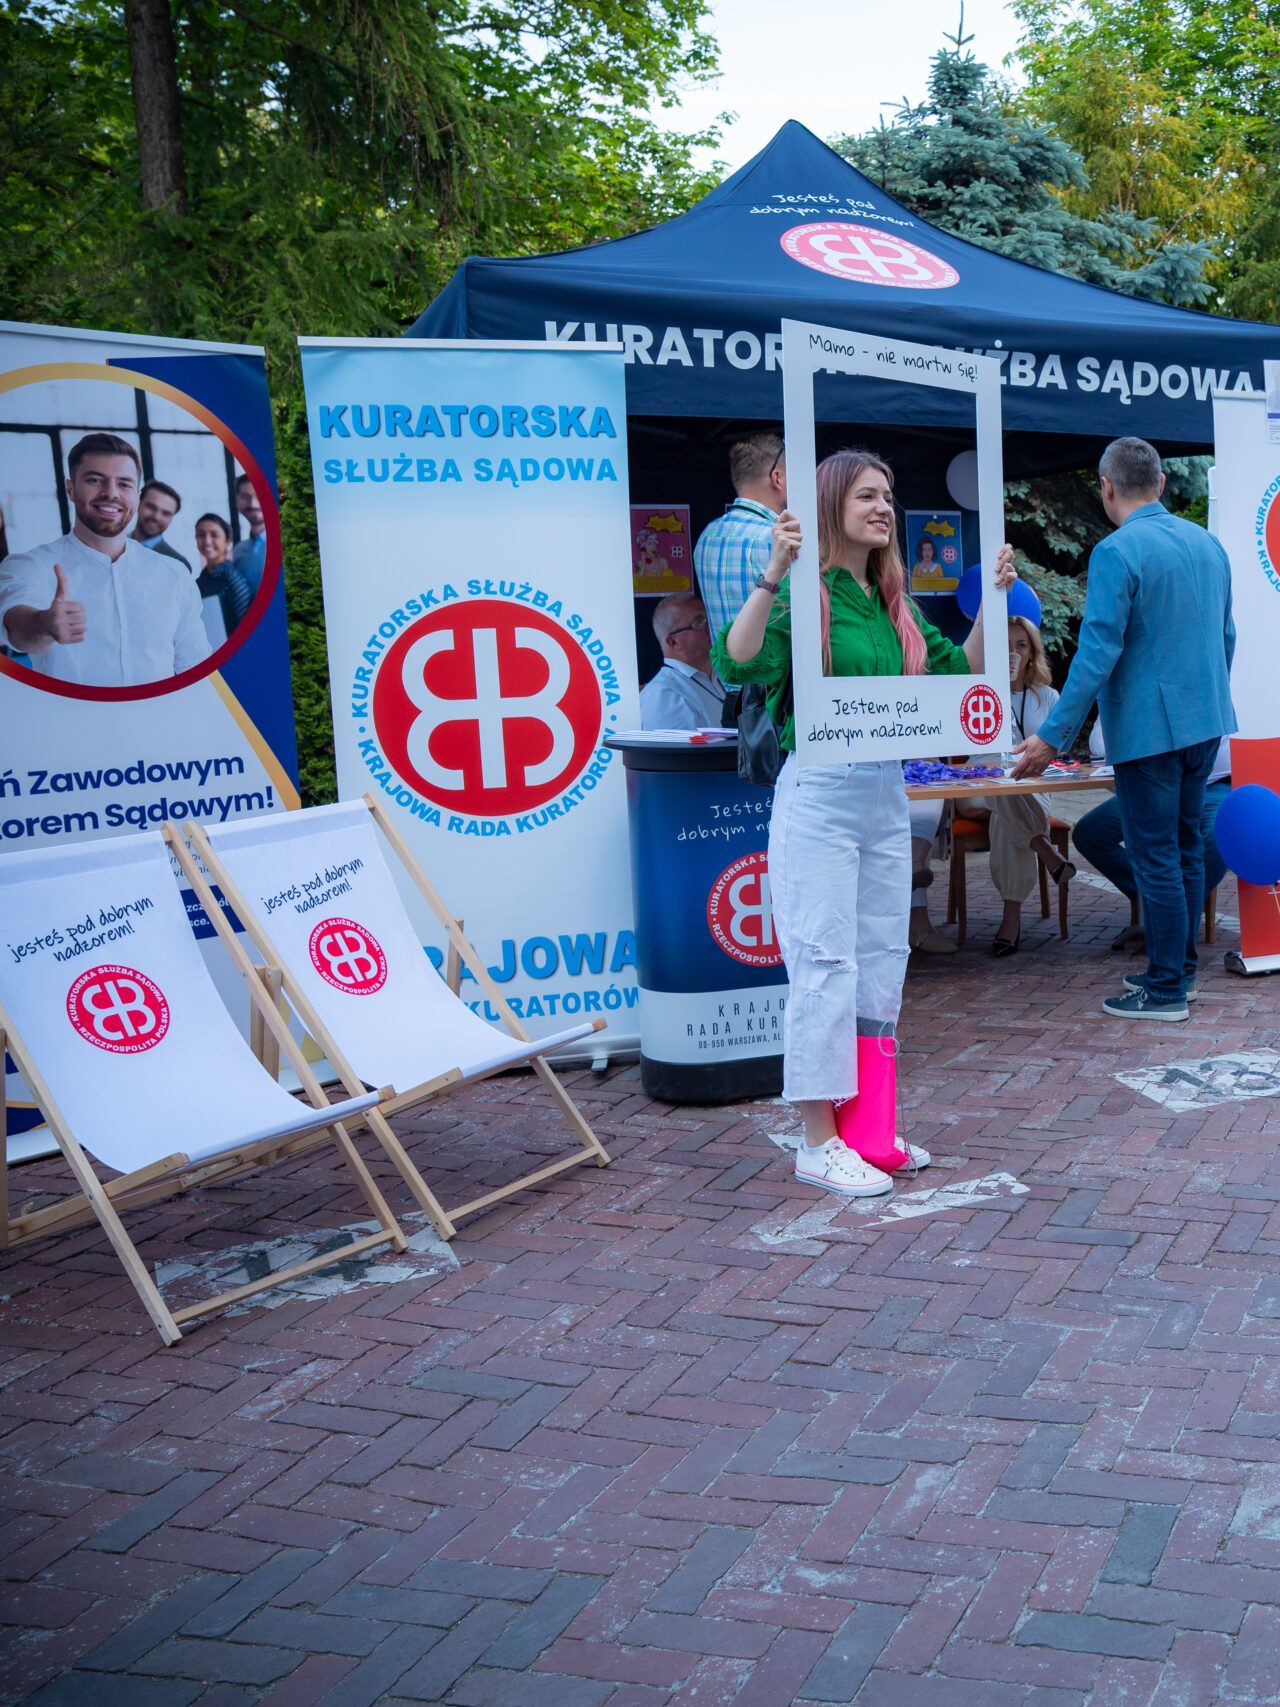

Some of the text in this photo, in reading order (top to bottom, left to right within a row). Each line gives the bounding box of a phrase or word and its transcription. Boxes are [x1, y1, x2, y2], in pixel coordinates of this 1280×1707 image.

[750, 205, 820, 216] dobrym
[772, 193, 876, 210] Jesteś pod
[809, 334, 855, 357] Mamo
[876, 346, 897, 364] nie
[903, 355, 952, 375] martw
[958, 362, 978, 383] się!
[1076, 357, 1255, 405] SĄDOWA
[319, 404, 617, 440] KURATORSKA
[323, 451, 618, 488] SŁUŻBA SĄDOWA
[351, 579, 621, 718] KURATORSKA SŁUŻBA SĄDOWA
[831, 697, 919, 719] Jestem pod
[808, 720, 943, 748] dobrym nadzorem!
[27, 756, 245, 796] Zawodowym
[357, 738, 441, 825] KRAJOWA
[448, 814, 511, 838] RADA
[0, 786, 275, 840] orem Sądowym!
[677, 825, 745, 841] dobrym
[260, 857, 364, 914] jesteś pod dobrym
[294, 878, 353, 914] nadzorem!
[710, 855, 756, 915] KURATORSKA
[7, 897, 154, 963] jesteś pod dobrym
[53, 920, 136, 962] nadzorem!
[69, 966, 164, 1022] KURATORSKA SŁUŻBA SĄDOWA
[79, 1006, 169, 1053] RZECZPOSPOLITA POLSKA
[687, 1015, 778, 1037] RADA KUR
[699, 1039, 724, 1049] 00-950
[728, 1034, 770, 1046] WARSZAWA,
